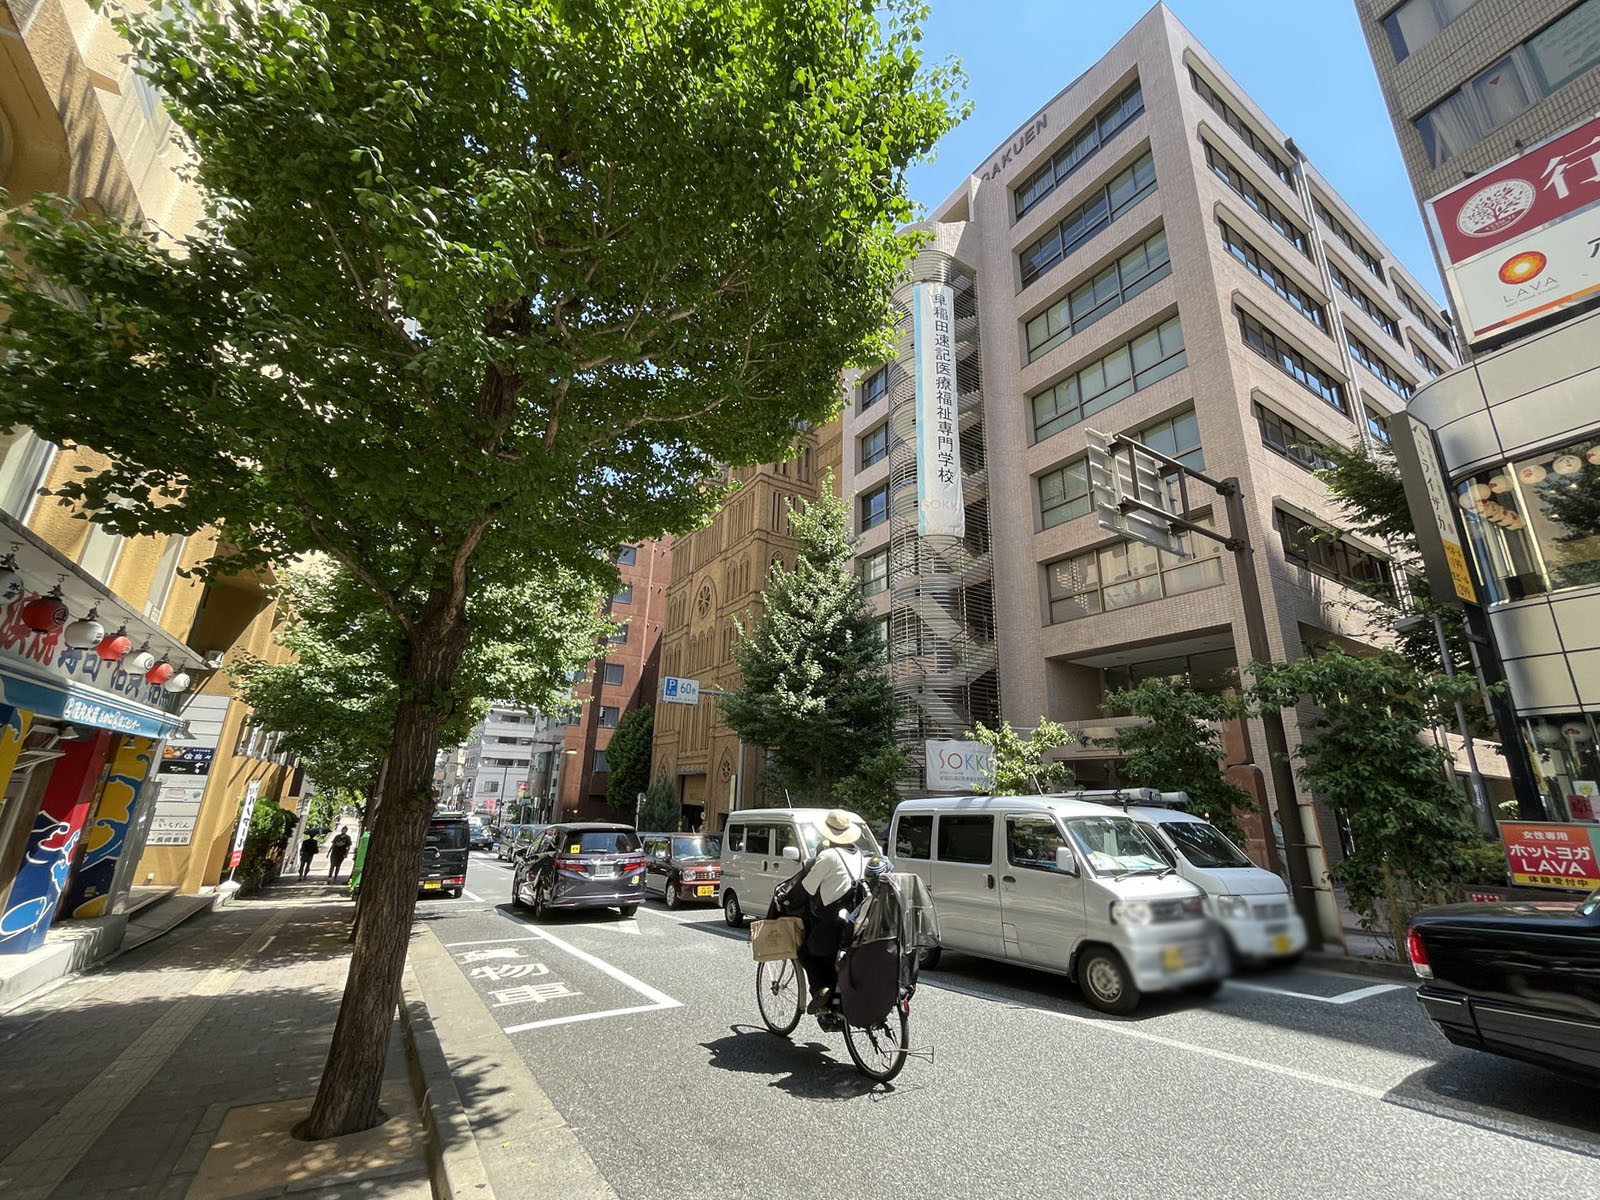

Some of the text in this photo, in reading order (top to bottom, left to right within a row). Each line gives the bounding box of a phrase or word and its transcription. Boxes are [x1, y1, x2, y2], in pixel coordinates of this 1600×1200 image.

[1503, 277, 1558, 303] LAVA
[934, 293, 954, 485] 早稲田速記医療福祉専門学校
[1418, 439, 1447, 532] ミライザカ
[1521, 830, 1568, 841] 女性専用
[1508, 843, 1591, 860] ホットヨガ
[1521, 858, 1587, 876] LAVA
[1527, 875, 1589, 887] 体験受付中
